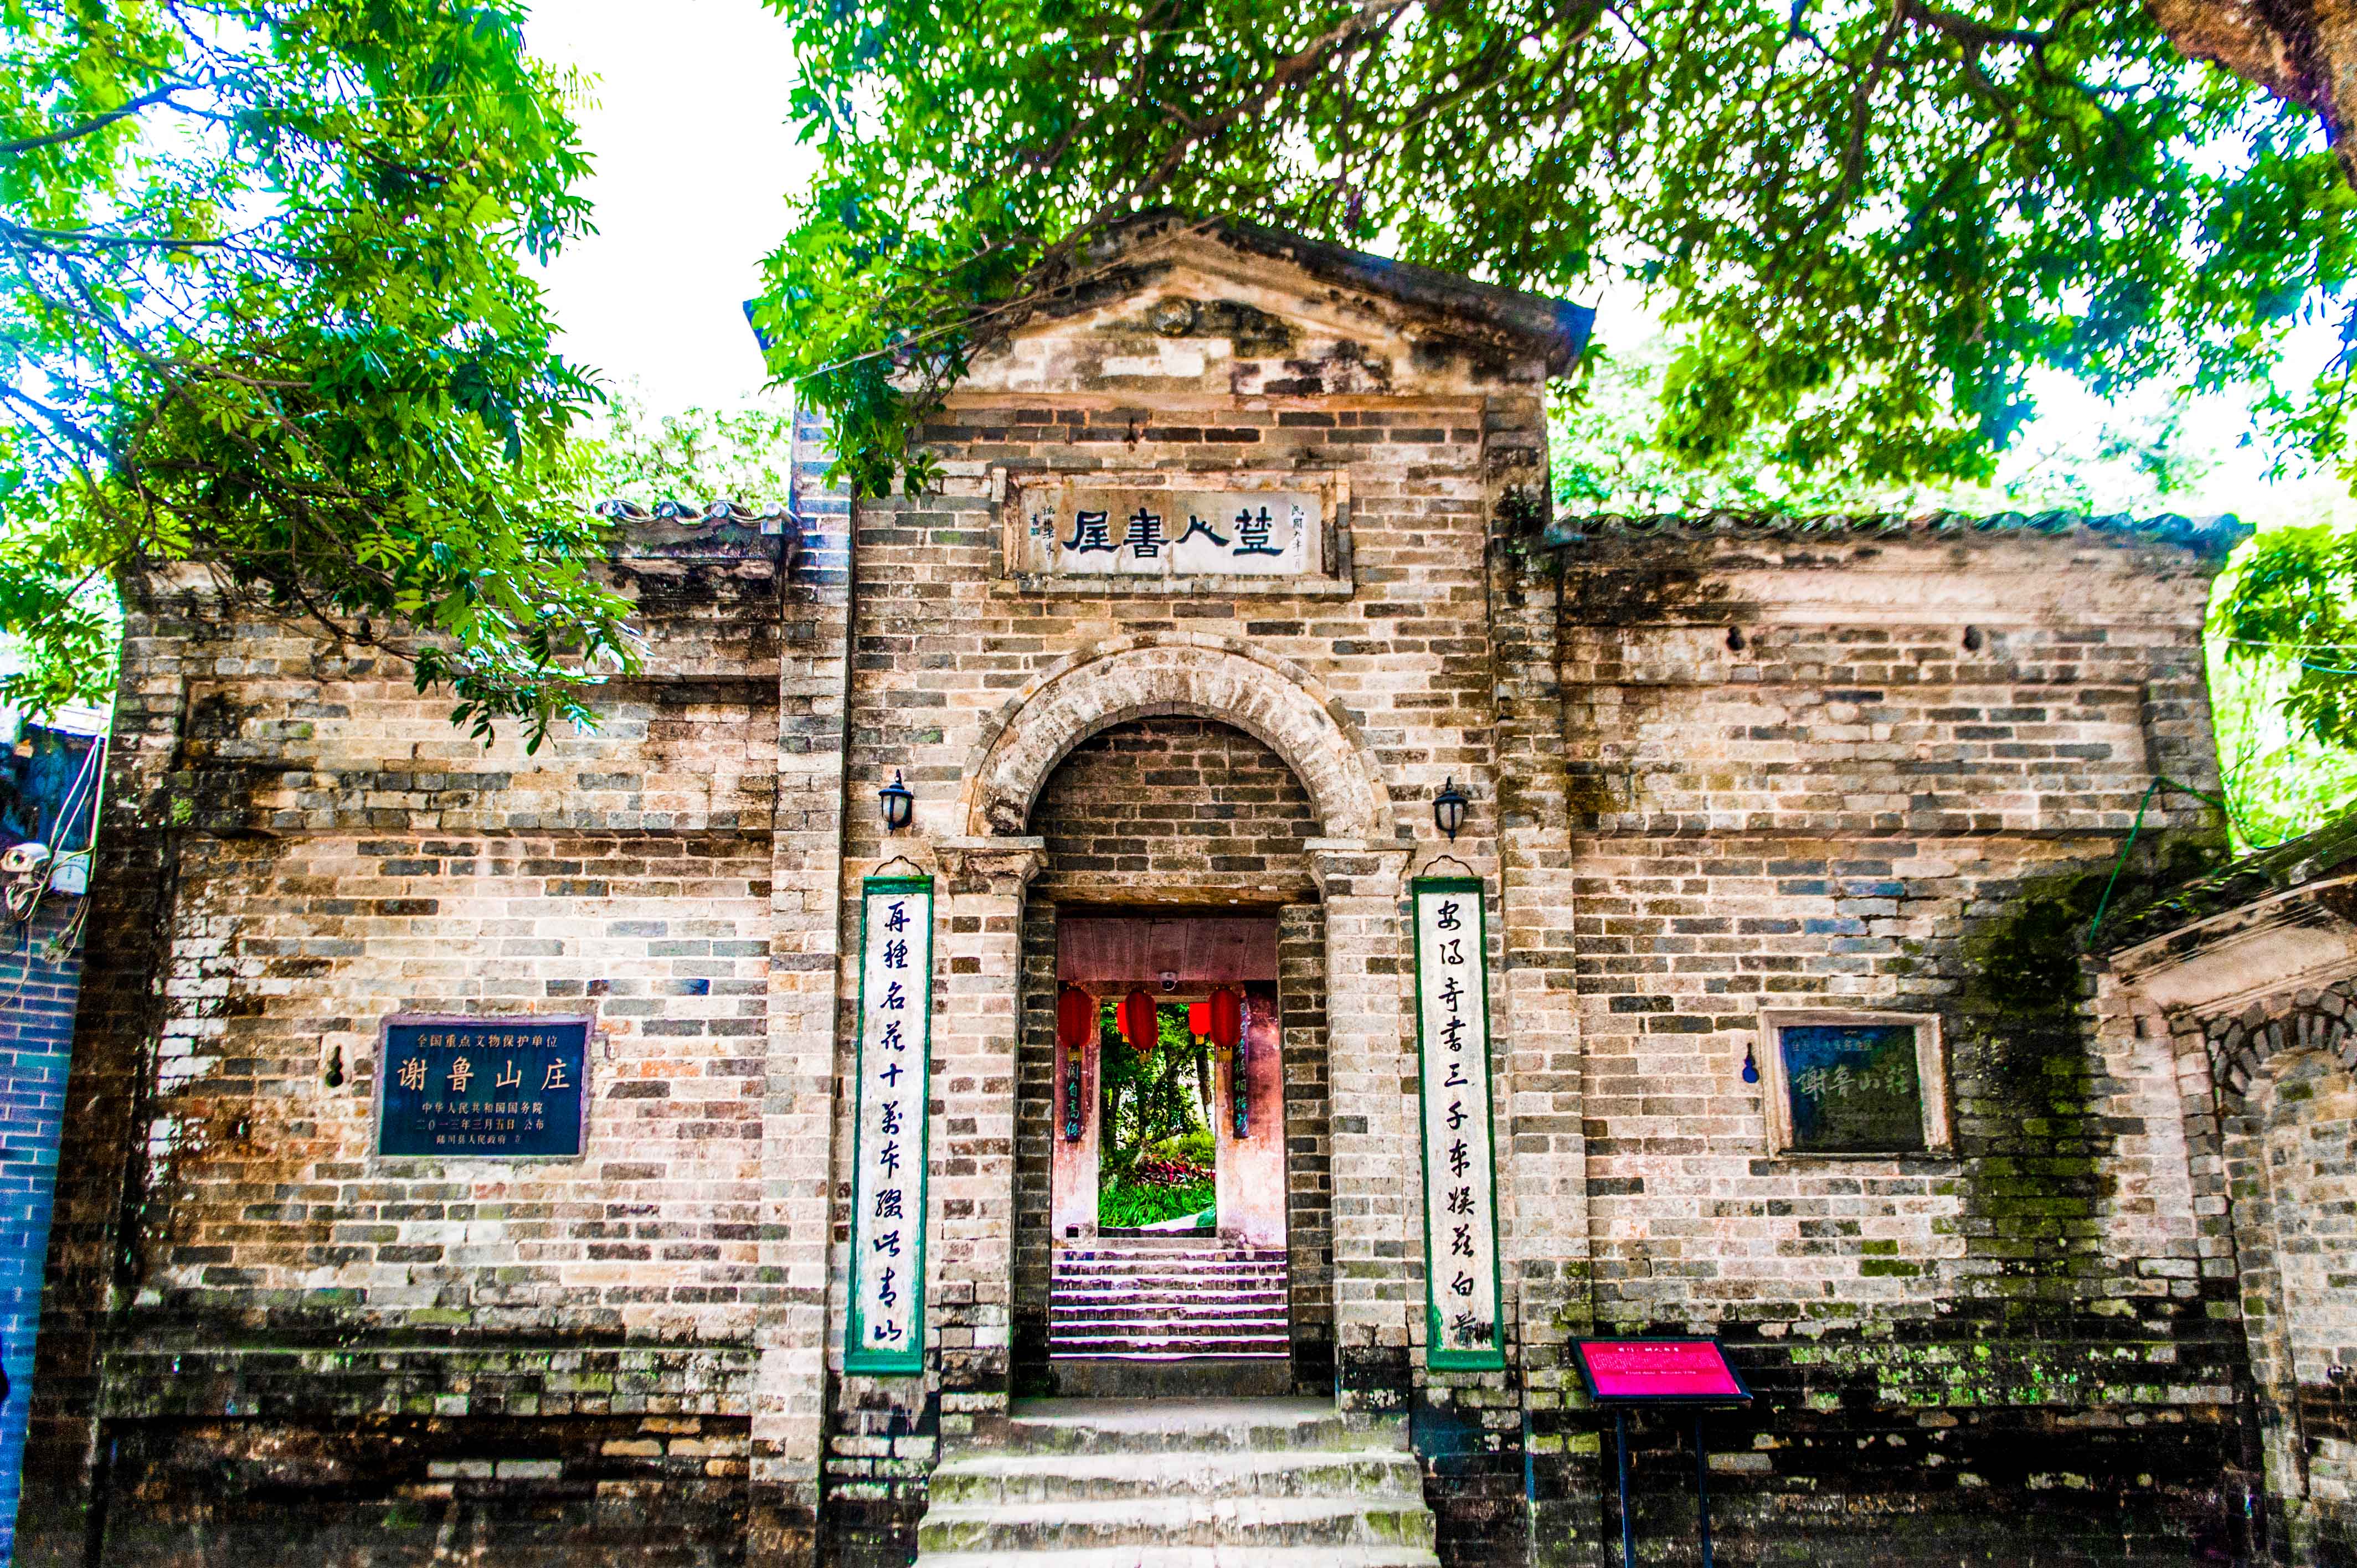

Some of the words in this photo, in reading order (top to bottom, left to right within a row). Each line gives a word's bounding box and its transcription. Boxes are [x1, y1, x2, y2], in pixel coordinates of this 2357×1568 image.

[416, 1034, 558, 1048] 全国重点文物保护单位
[397, 1055, 570, 1093] 谢鲁山庄
[421, 1101, 543, 1115] 中华人民共和国国务院
